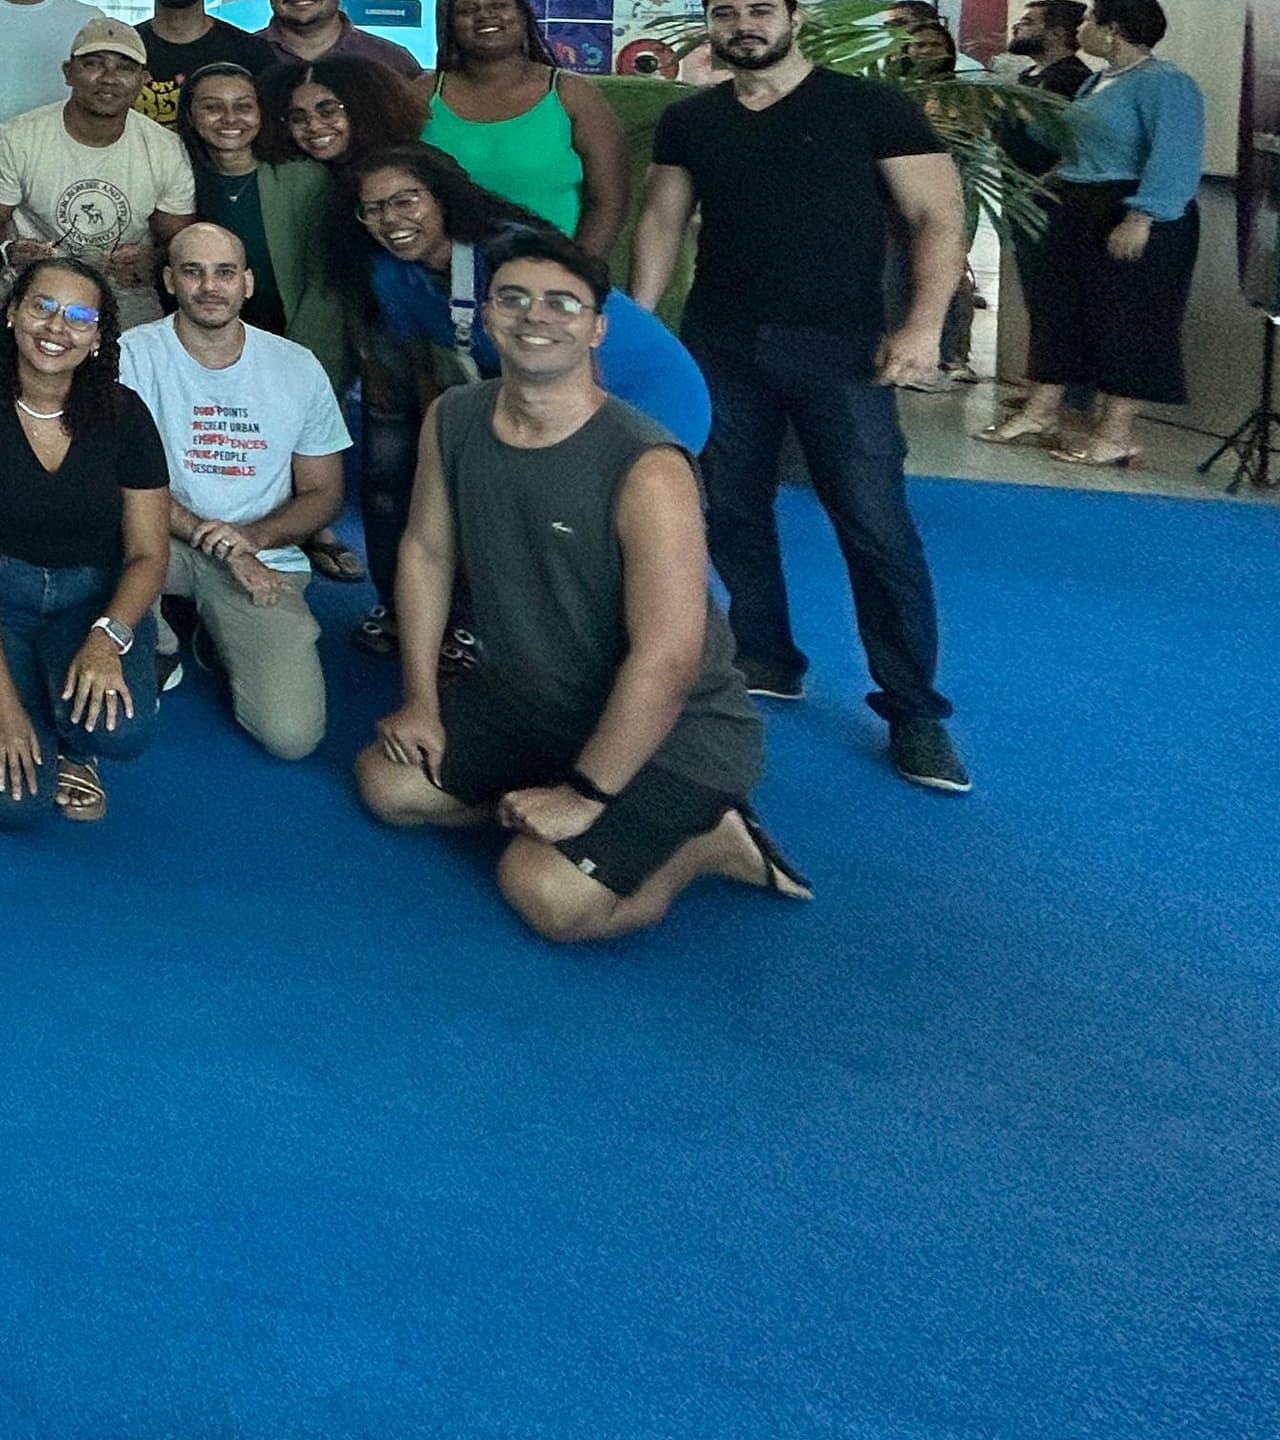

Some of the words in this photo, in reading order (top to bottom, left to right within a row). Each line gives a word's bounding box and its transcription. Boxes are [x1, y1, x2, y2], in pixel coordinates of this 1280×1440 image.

[215, 406, 249, 418] POINTS
[229, 422, 260, 433] URBAN
[214, 450, 248, 462] PEOPLE
